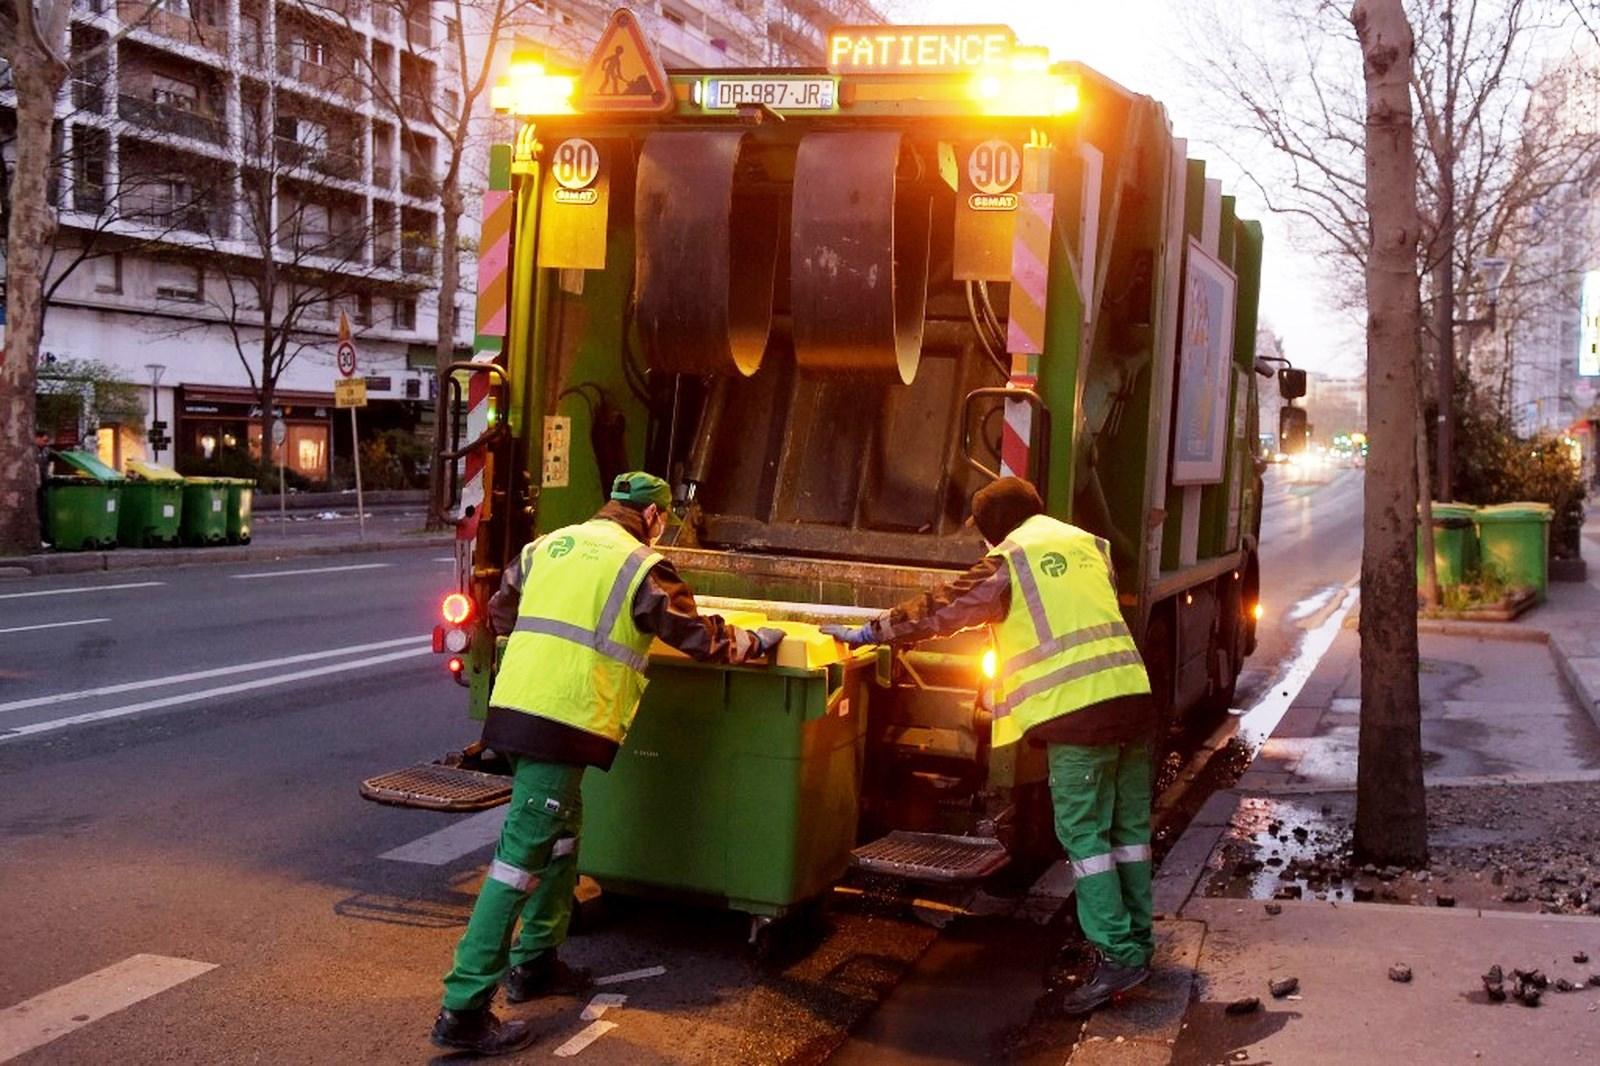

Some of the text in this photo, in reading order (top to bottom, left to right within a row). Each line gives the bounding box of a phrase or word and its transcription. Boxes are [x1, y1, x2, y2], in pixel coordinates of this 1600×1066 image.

[831, 35, 1006, 66] PATIENCE
[560, 144, 592, 182] 80
[975, 145, 1012, 187] 90
[341, 352, 354, 367] 30
